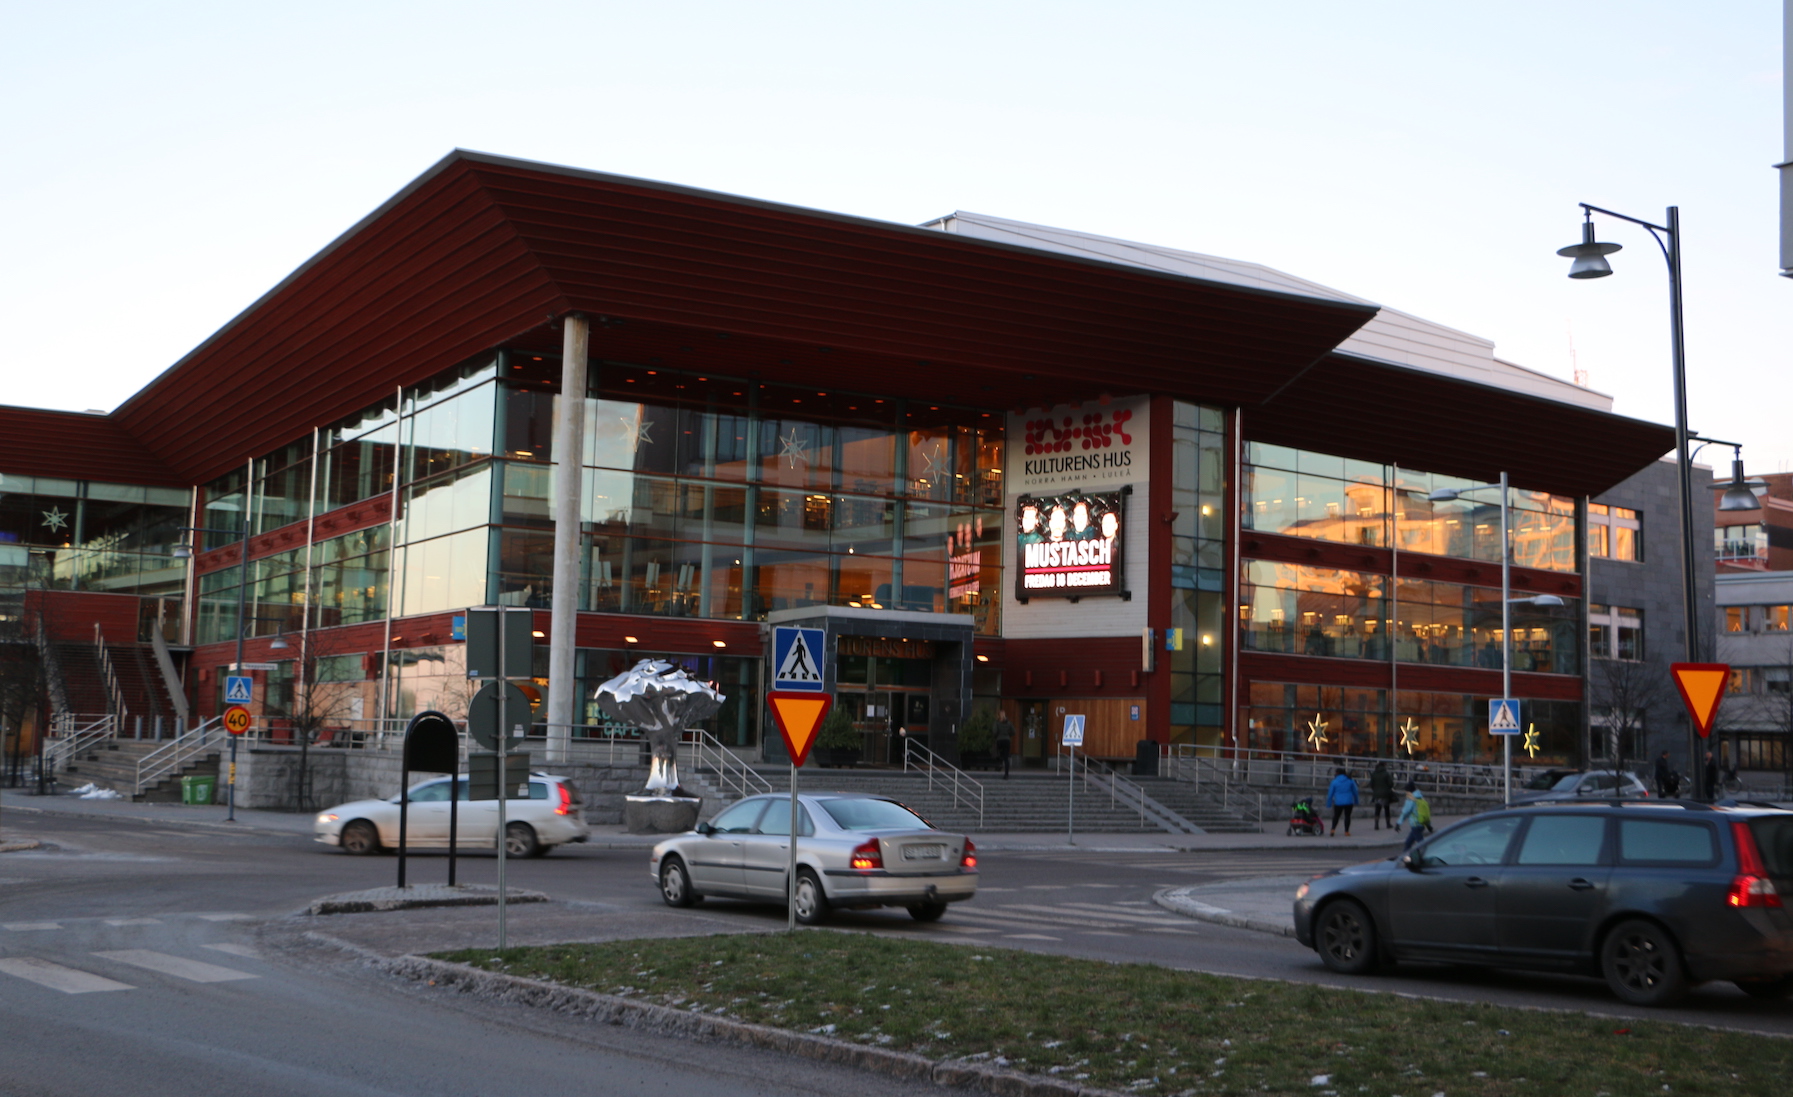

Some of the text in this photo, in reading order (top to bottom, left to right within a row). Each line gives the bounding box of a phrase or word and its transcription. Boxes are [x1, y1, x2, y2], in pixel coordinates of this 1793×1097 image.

[1025, 450, 1132, 476] KULTURENS HUS
[1025, 468, 1131, 486] NORRA HAMN LULEÅ
[1025, 539, 1112, 568] MUSTASCH
[1024, 573, 1056, 589] FREDAG
[1066, 571, 1111, 587] DECEMBER
[905, 641, 933, 659] HUS
[228, 714, 247, 727] 40
